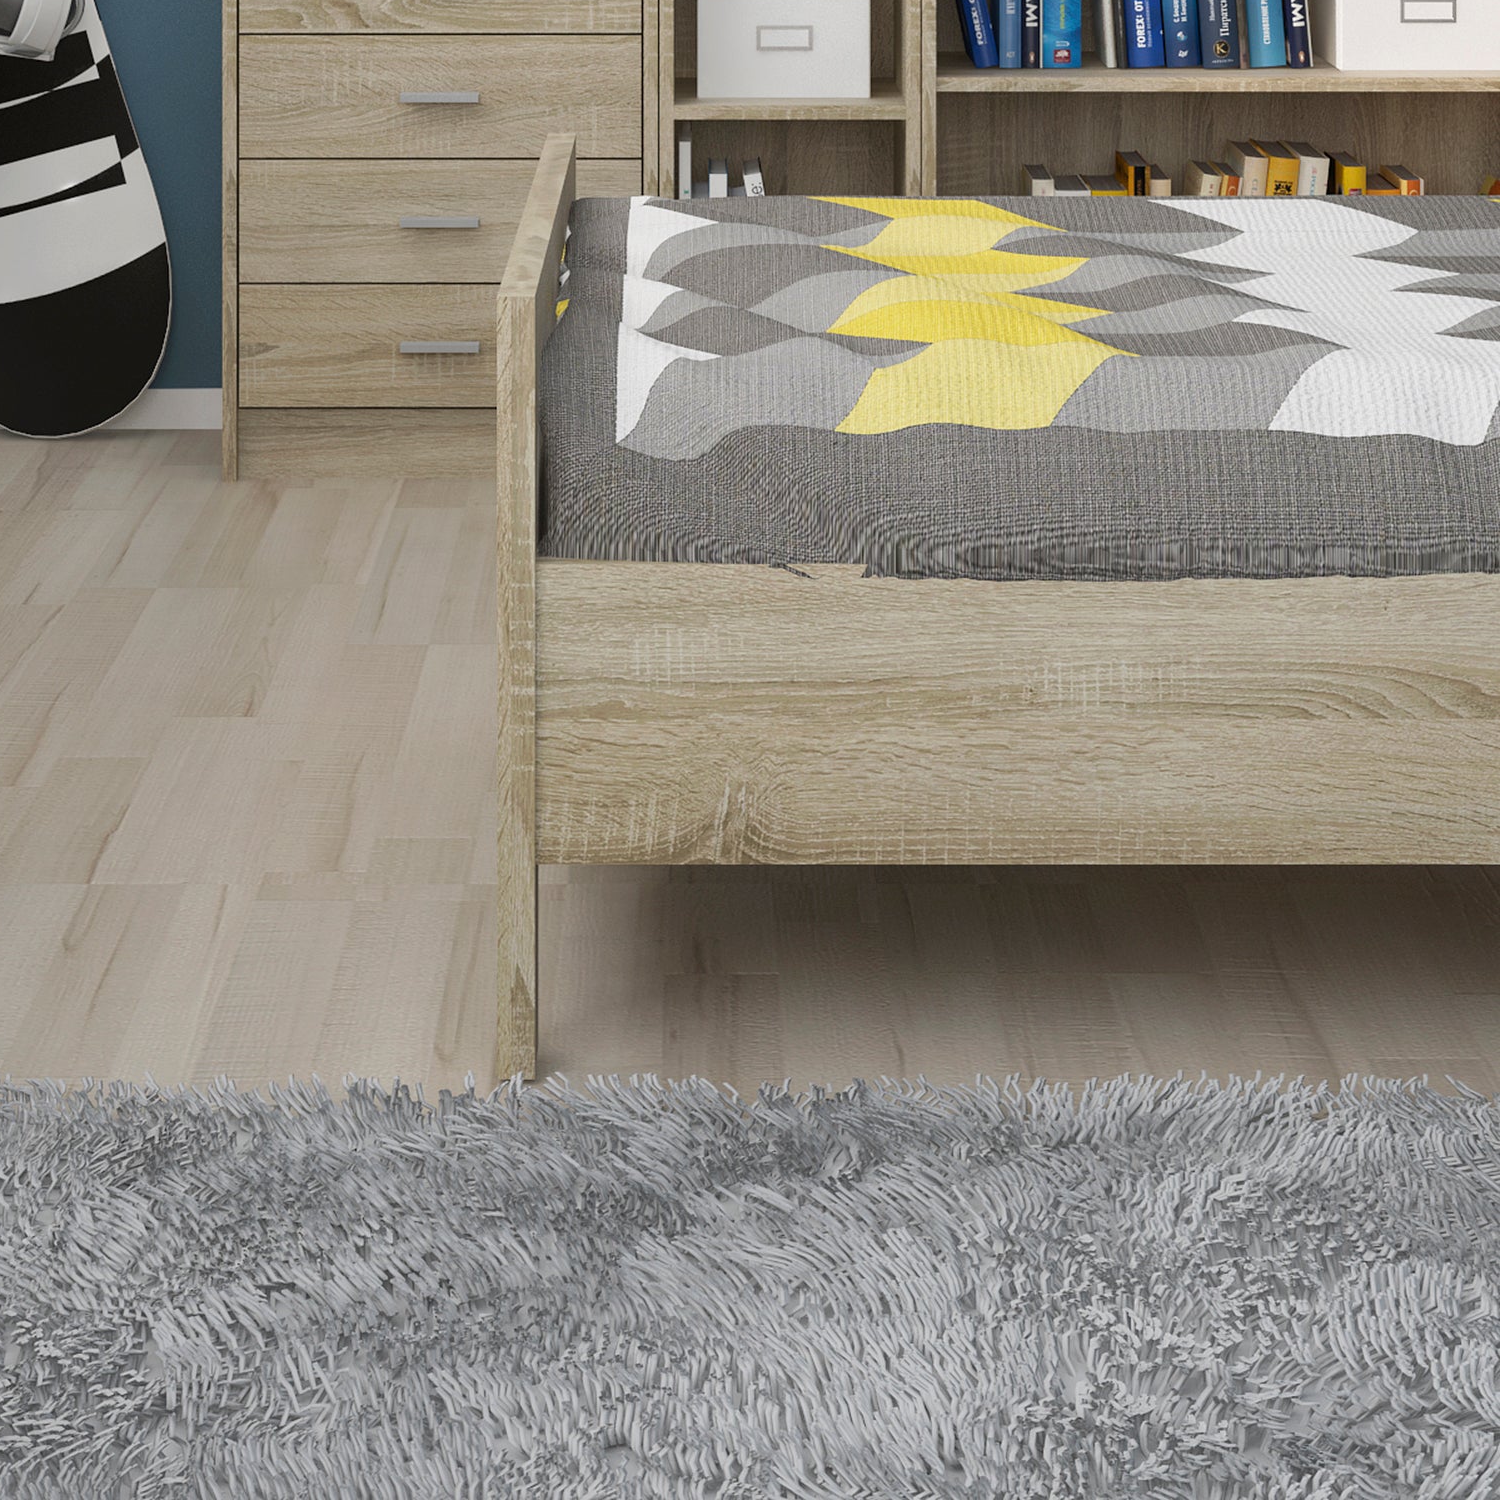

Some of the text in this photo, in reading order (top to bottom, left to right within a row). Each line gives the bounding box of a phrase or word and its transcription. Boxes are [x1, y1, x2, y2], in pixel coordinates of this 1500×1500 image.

[1133, 0, 1144, 12] ОТ
[971, 7, 984, 46] FOREX:
[1136, 14, 1147, 48] FOREX:
[1262, 5, 1271, 45] СТАНОВЛЕНИЕ
